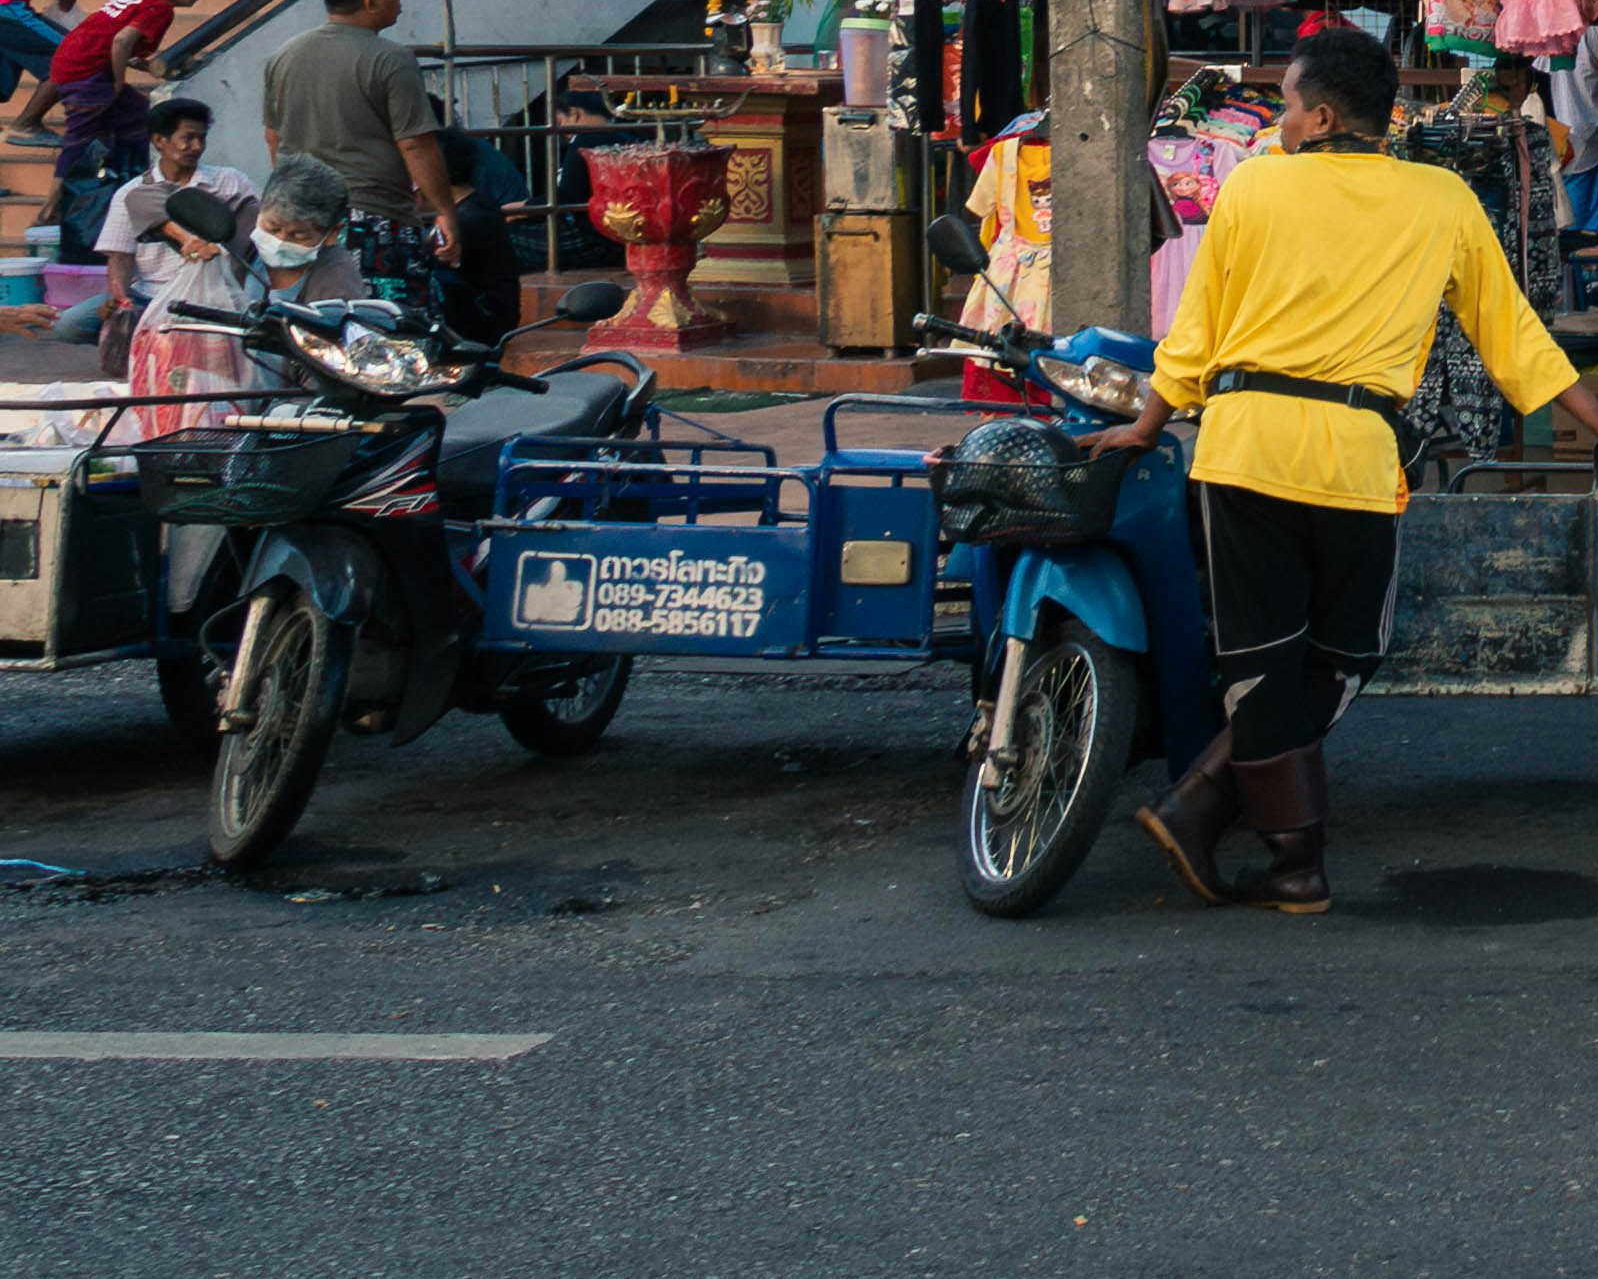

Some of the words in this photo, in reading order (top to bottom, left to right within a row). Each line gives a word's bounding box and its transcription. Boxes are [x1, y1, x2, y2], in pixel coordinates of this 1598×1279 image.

[600, 550, 766, 585] ถาวรโลหะกิจ
[597, 582, 764, 612] 089-7344623
[594, 608, 761, 638] 088-5856117
